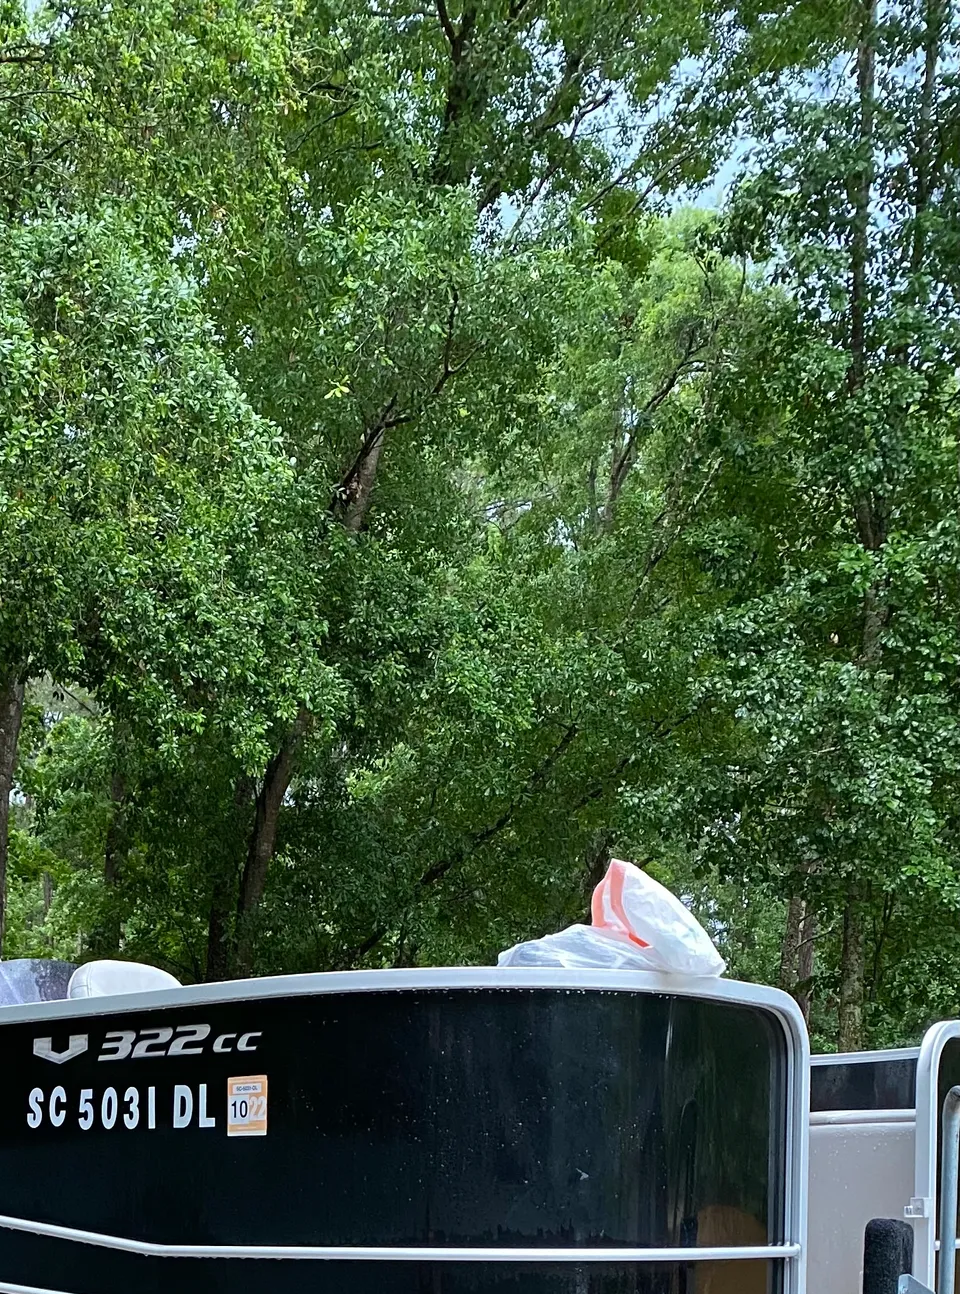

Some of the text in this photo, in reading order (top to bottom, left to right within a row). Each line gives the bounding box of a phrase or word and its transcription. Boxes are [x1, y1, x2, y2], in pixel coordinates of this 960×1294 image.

[97, 1023, 211, 1061] 322
[26, 1083, 216, 1130] SC 5031 DL
[231, 1100, 248, 1118] 10
